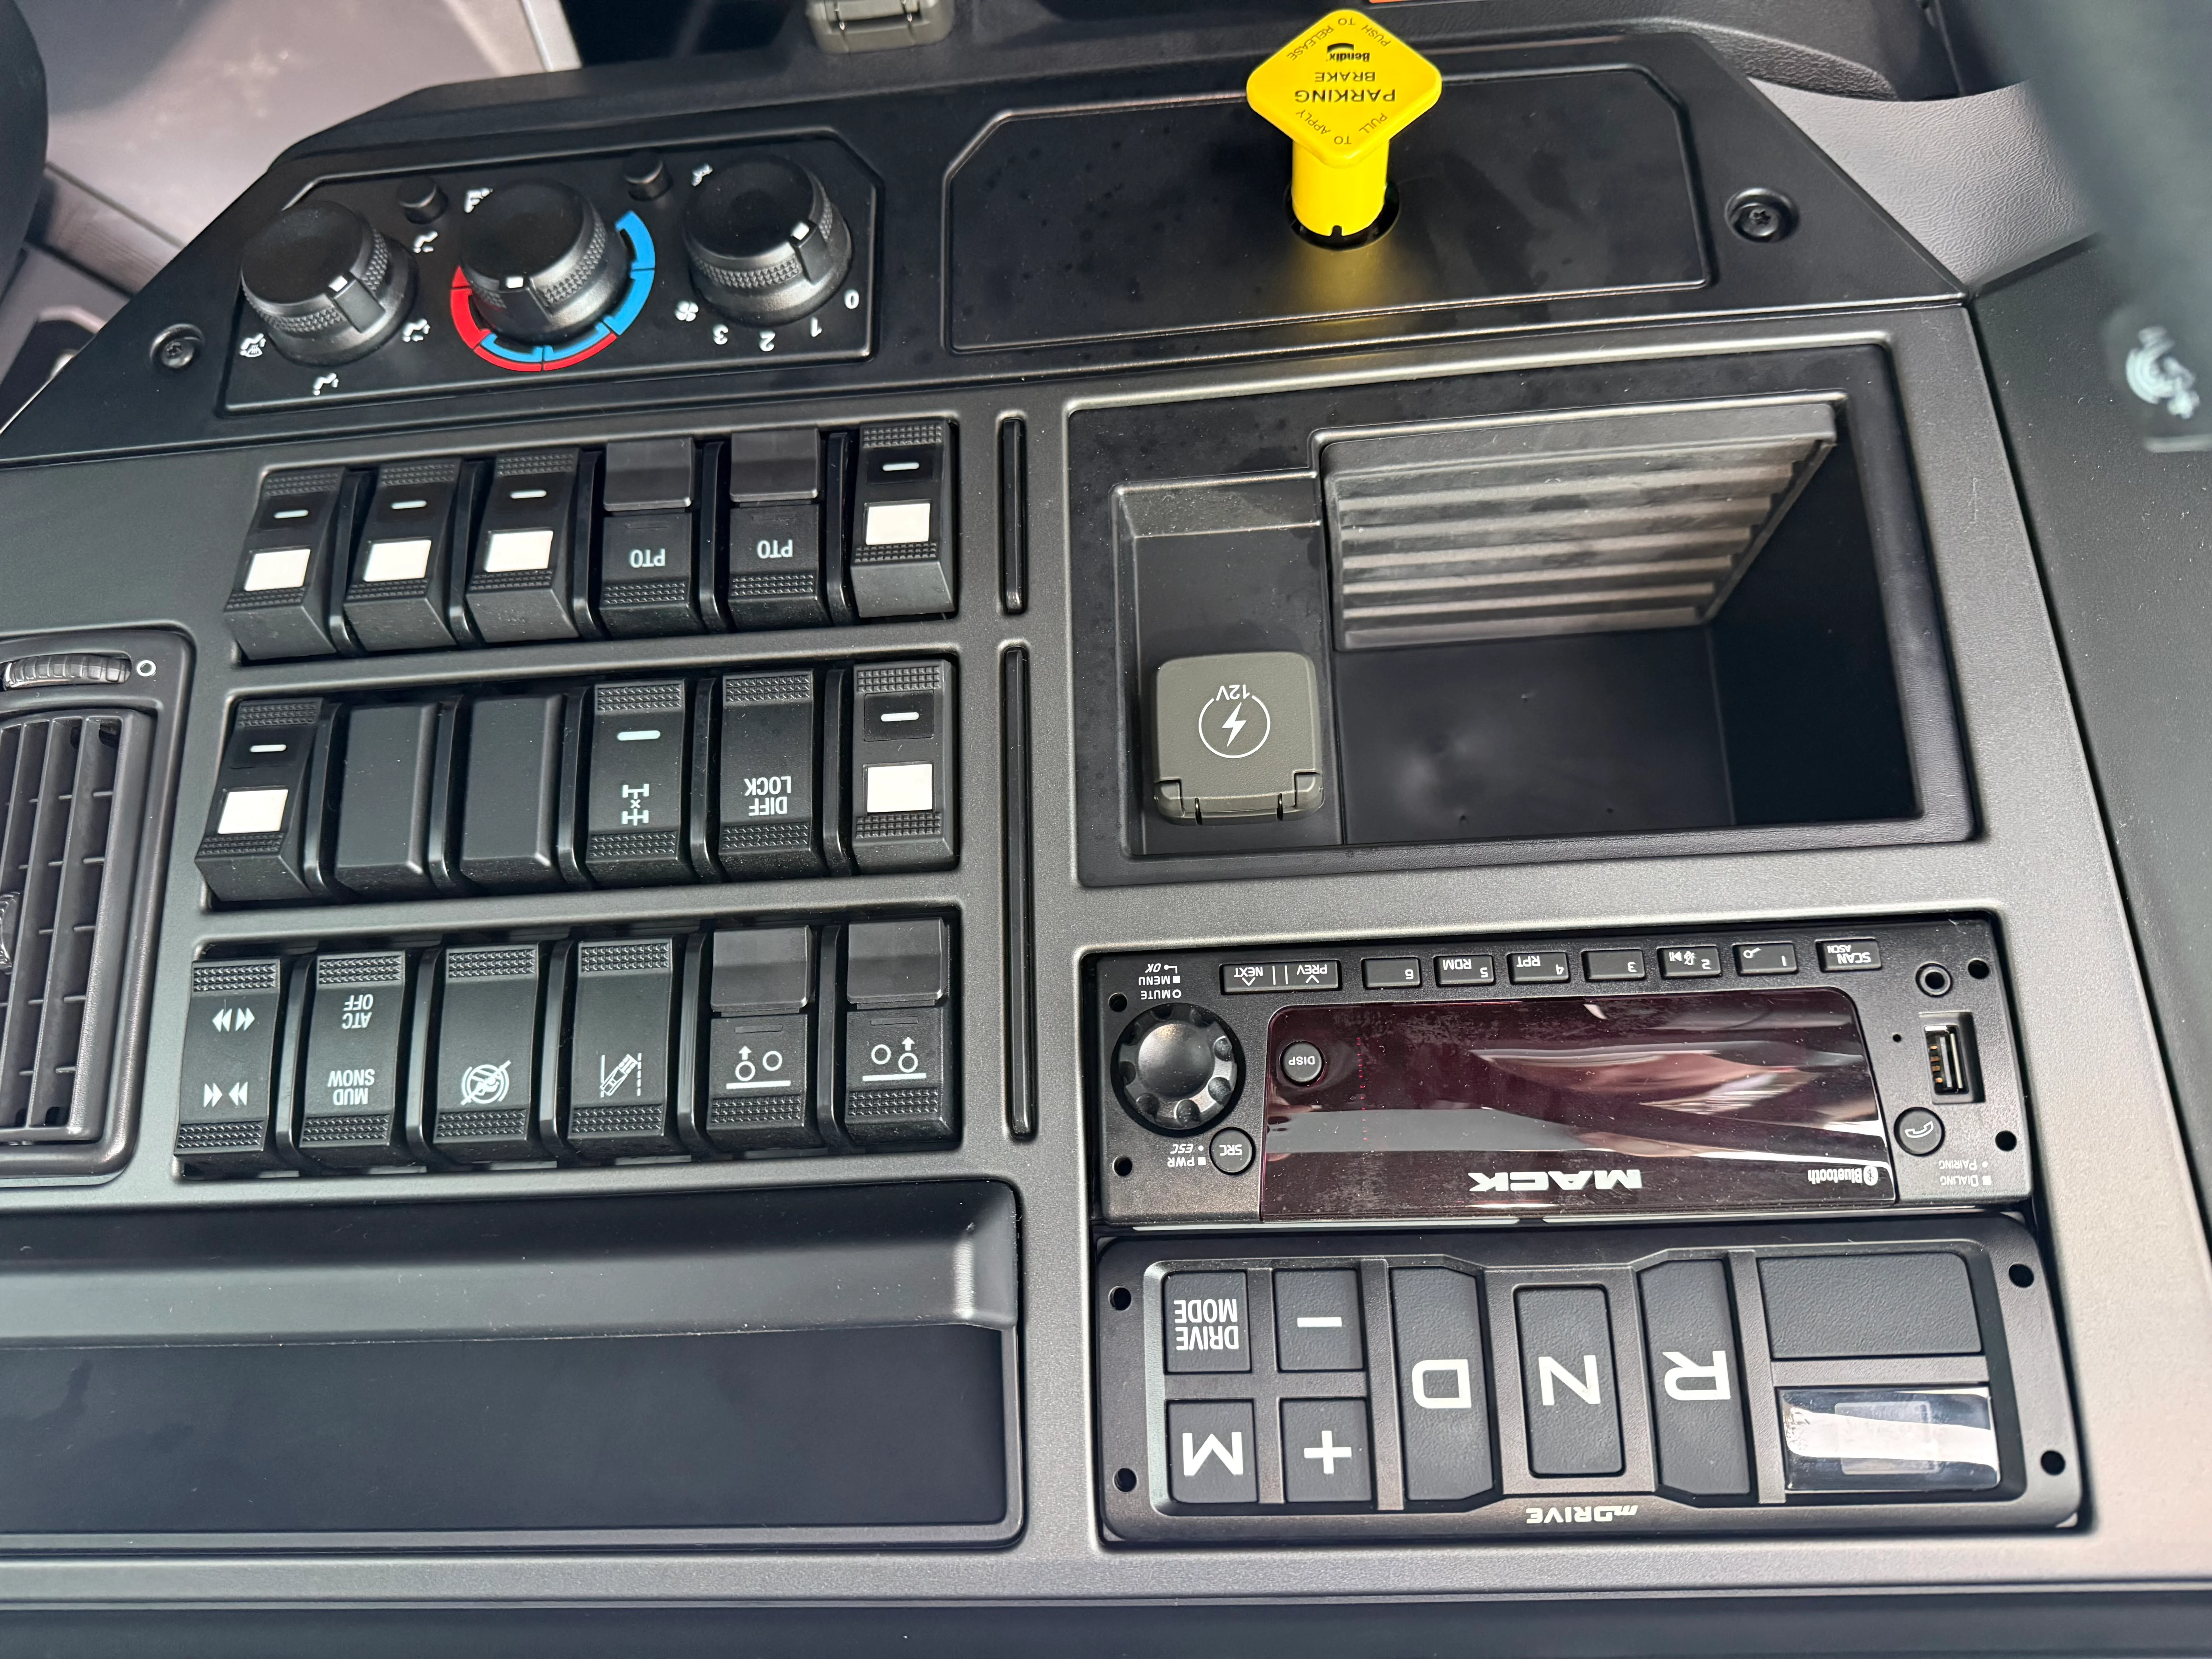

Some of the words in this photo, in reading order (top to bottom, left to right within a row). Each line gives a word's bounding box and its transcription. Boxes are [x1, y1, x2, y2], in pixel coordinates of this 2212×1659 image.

[1287, 25, 1334, 61] RELEASE
[1362, 24, 1391, 46] PUSH
[1330, 53, 1370, 62] Bendix
[1315, 72, 1375, 82] BRAKE
[1295, 89, 1395, 101] PARKING
[1297, 110, 1331, 134] APPLY
[1359, 113, 1387, 133] PULL
[1334, 136, 1351, 144] TO
[845, 290, 859, 309] 0
[714, 325, 728, 344] 3
[811, 318, 822, 337] 1
[760, 332, 775, 351] 2
[757, 540, 792, 558] PTO
[630, 549, 665, 568] PTO
[1216, 684, 1250, 701] 12V
[744, 776, 791, 796] LOCK
[749, 797, 787, 816] DIFF
[1827, 945, 1851, 953] ASCN
[1443, 959, 1472, 970] RDM
[1516, 956, 1540, 967] RPT
[1701, 959, 1711, 969] 2
[1782, 956, 1787, 966] 1
[1837, 952, 1871, 964] SCAN
[1145, 963, 1161, 973] OK
[1234, 967, 1263, 977] NEXT
[1297, 964, 1327, 975] PREV
[1405, 969, 1413, 979] 6
[1480, 967, 1488, 977] 5
[1556, 964, 1564, 975] 4
[1628, 962, 1637, 972] 3
[1139, 975, 1170, 986] MENU
[343, 994, 373, 1011] OFF
[1141, 990, 1170, 1000] MUTE
[342, 1012, 372, 1029] ATC
[1288, 1056, 1315, 1065] DISP
[328, 1069, 375, 1087] SNOW
[333, 1088, 368, 1105] MUD
[1170, 1144, 1194, 1154] ESC
[1219, 1144, 1242, 1156] SRC
[1167, 1157, 1195, 1167] PWR
[1468, 1170, 1642, 1192] MACK
[1808, 1168, 1862, 1184] Bluetooth
[1174, 1299, 1238, 1323] MODE
[1175, 1326, 1239, 1350] DRIVE
[1412, 1359, 1472, 1408] D
[1538, 1355, 1601, 1405] N
[1662, 1351, 1730, 1400] R
[1183, 1432, 1243, 1476] M
